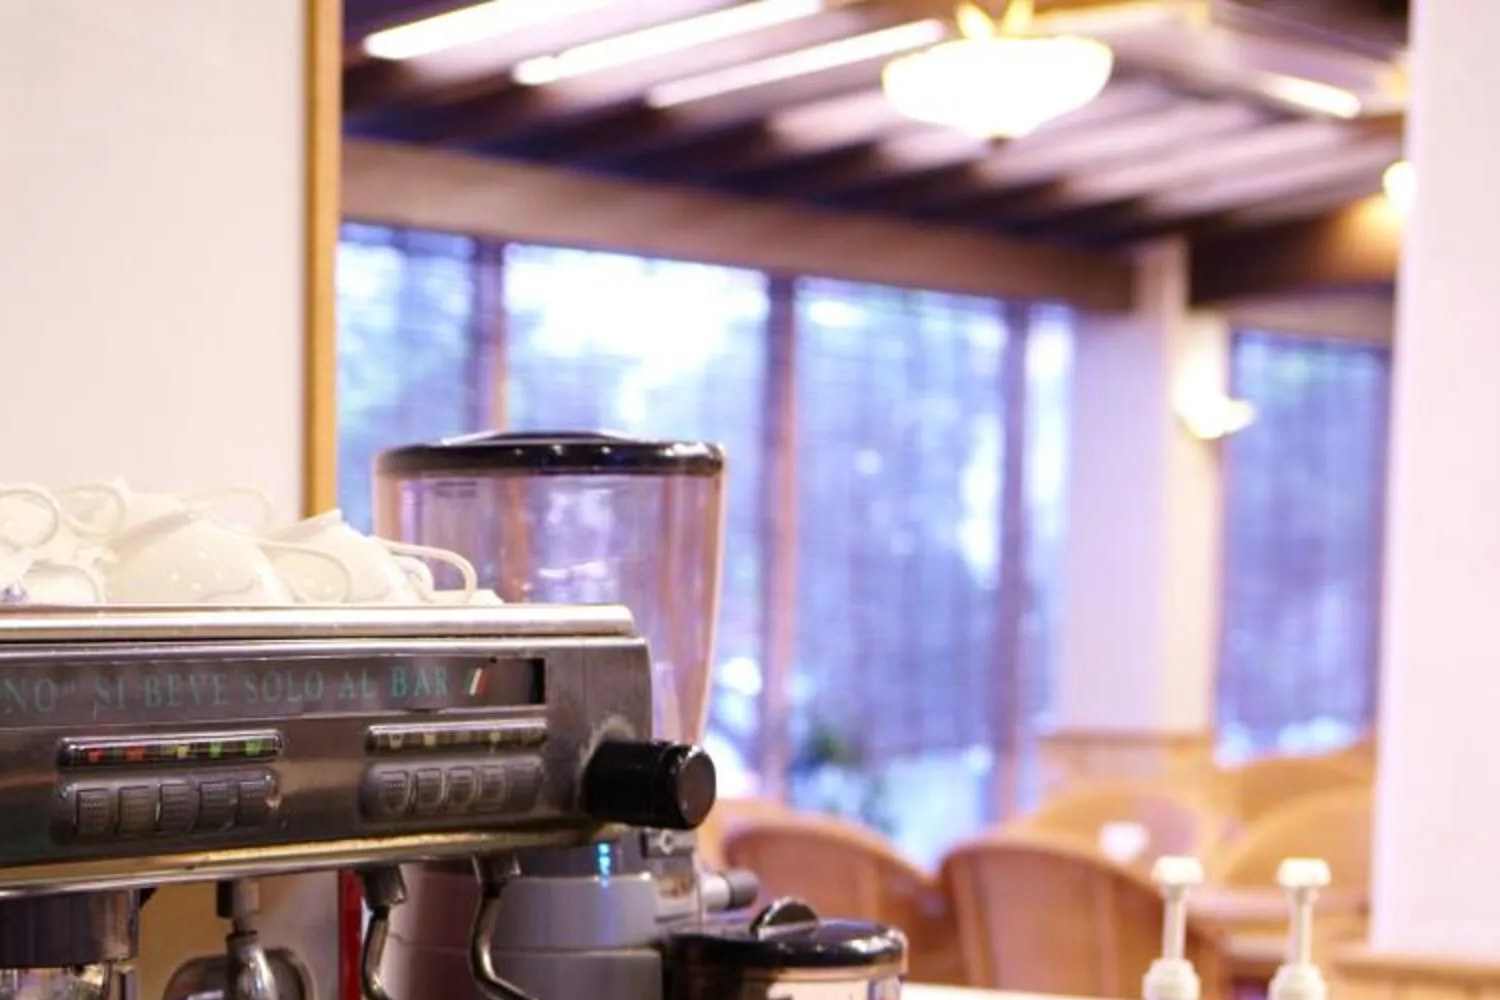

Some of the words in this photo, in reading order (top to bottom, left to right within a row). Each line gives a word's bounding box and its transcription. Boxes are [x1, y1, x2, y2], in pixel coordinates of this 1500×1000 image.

[143, 672, 229, 707] BEVE
[243, 670, 325, 705] SOLO
[337, 669, 378, 701] AL
[390, 666, 450, 698] BAR
